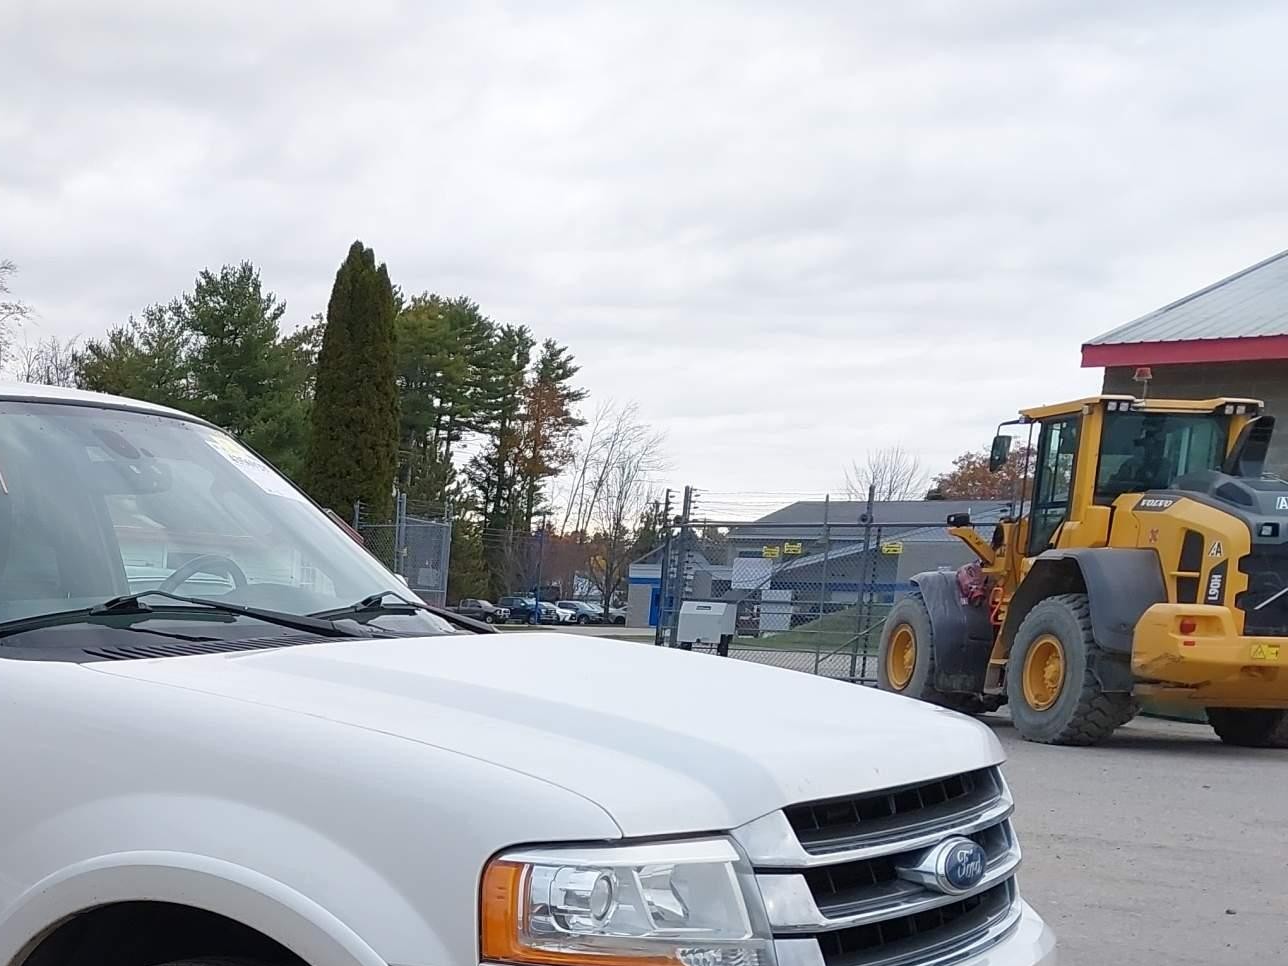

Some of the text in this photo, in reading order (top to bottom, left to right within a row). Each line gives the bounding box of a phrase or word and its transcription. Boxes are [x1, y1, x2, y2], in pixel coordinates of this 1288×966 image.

[1139, 499, 1174, 508] VOLVO
[1208, 574, 1223, 601] L90H
[956, 848, 983, 879] Ford
